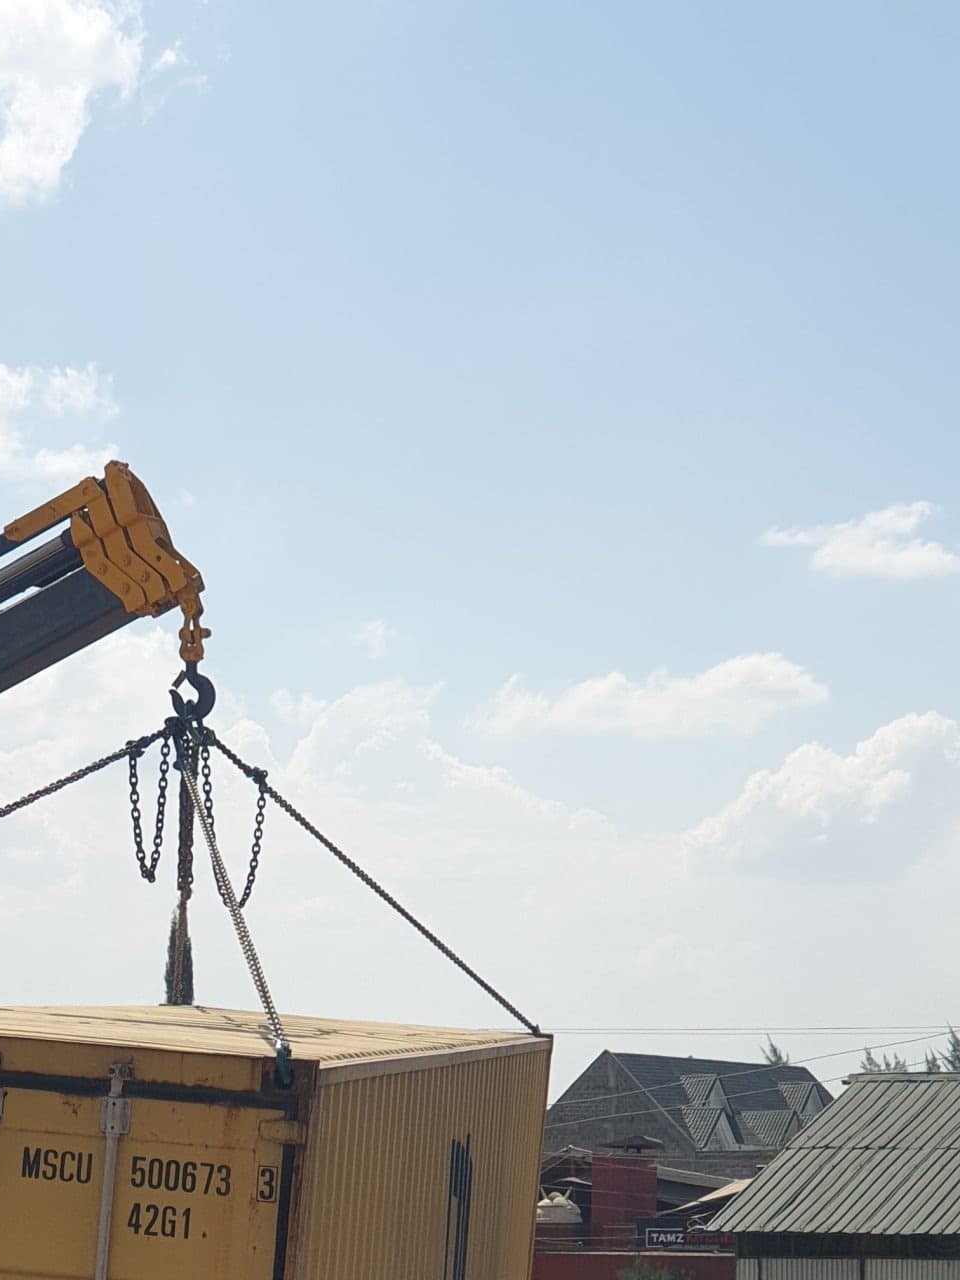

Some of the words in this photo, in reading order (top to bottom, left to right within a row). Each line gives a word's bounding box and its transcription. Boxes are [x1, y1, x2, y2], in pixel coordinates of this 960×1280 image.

[20, 1146, 93, 1184] MSCU
[130, 1156, 232, 1197] 500673
[258, 1167, 276, 1201] 3
[651, 1233, 684, 1243] TAMZ
